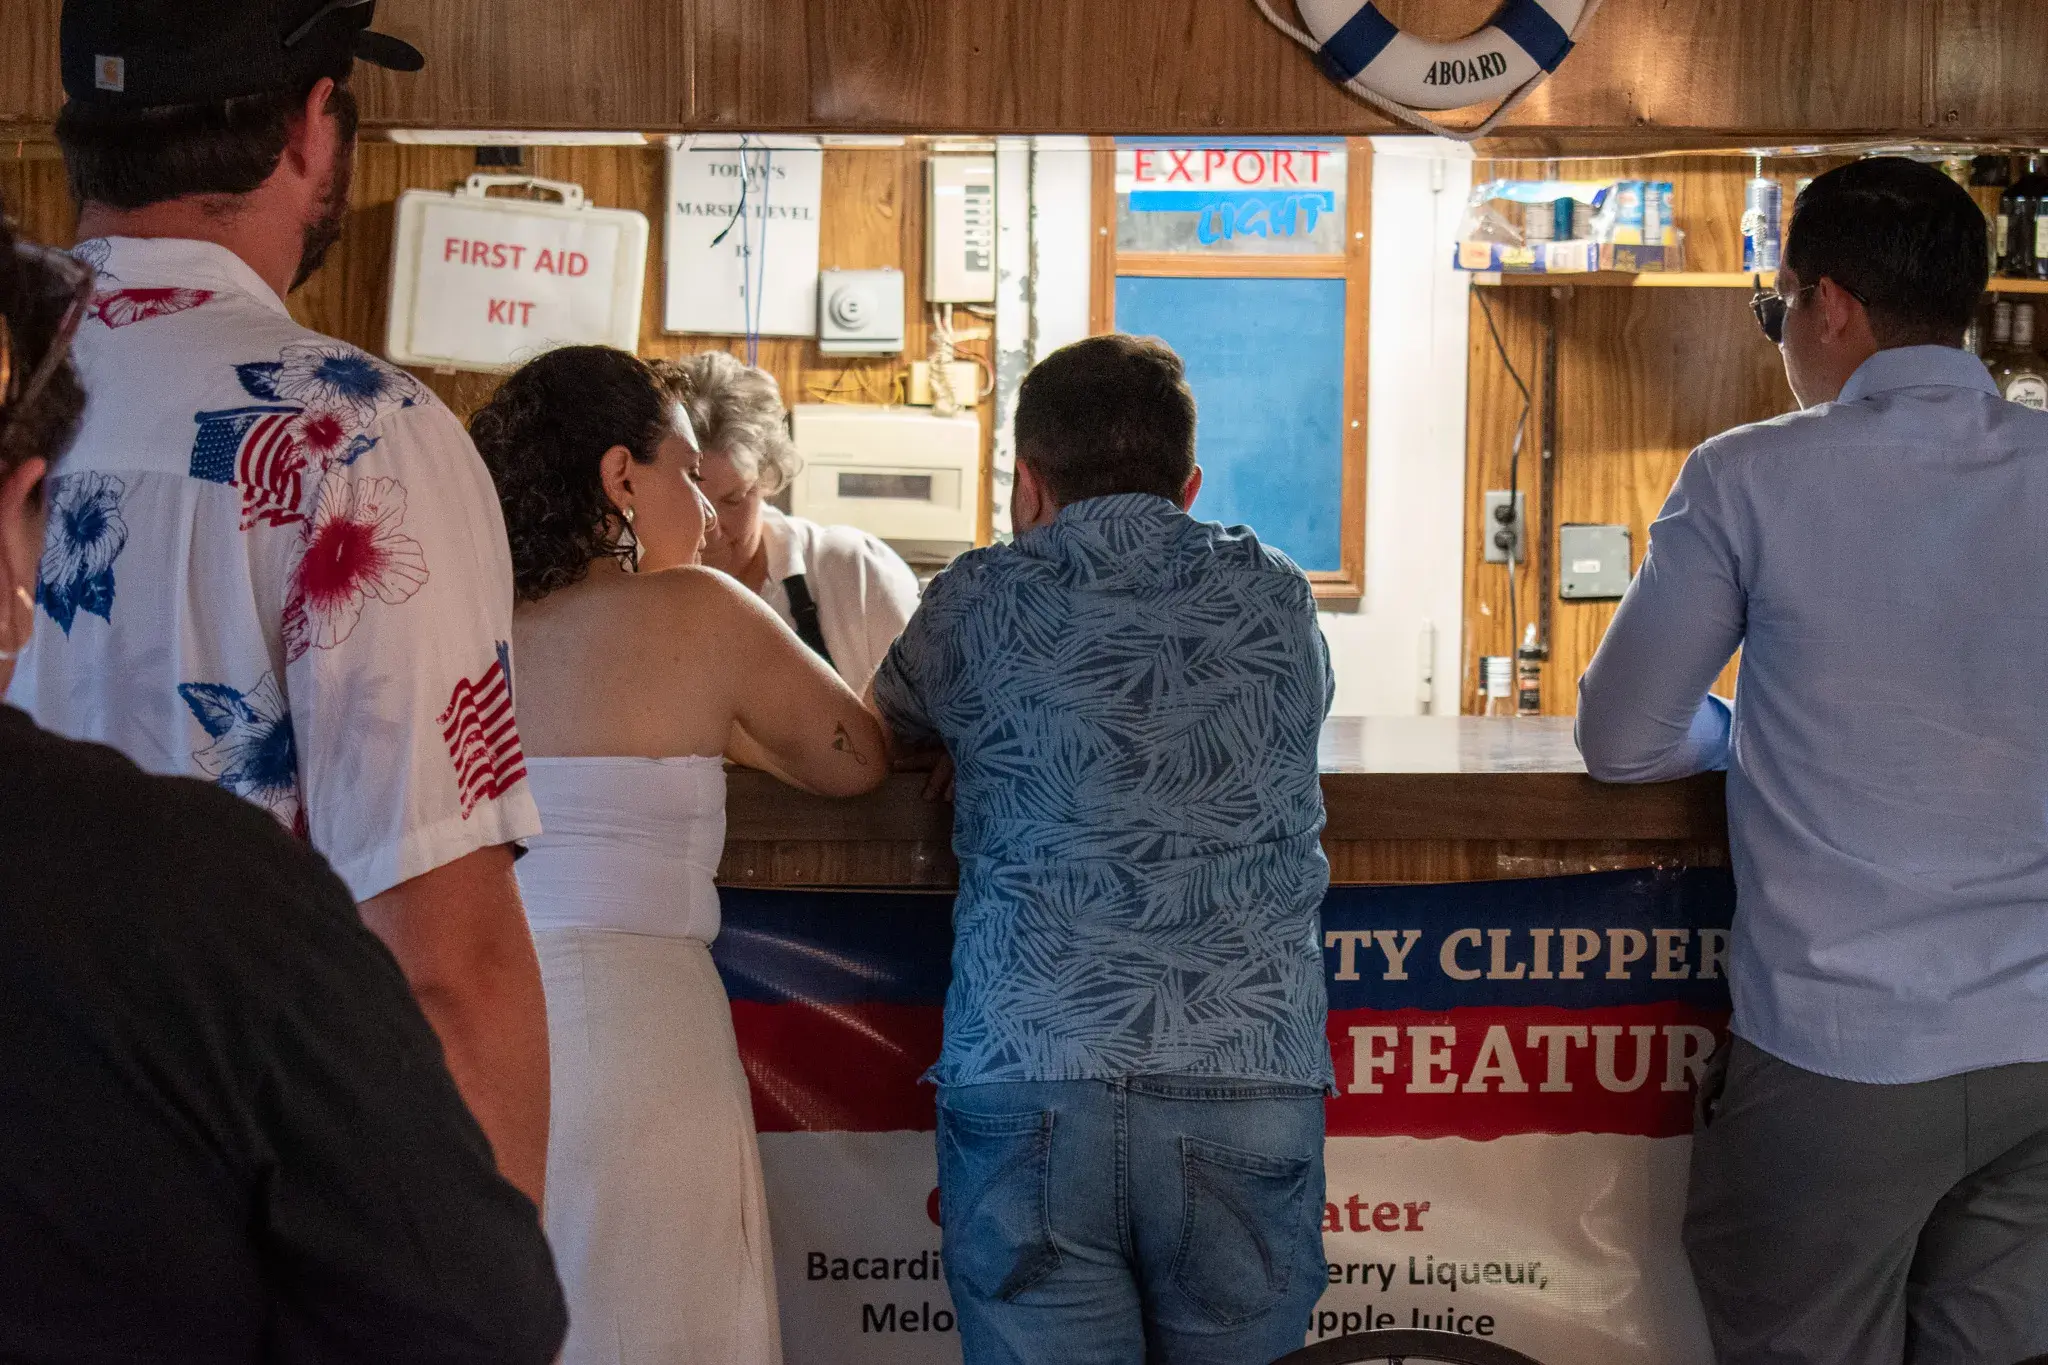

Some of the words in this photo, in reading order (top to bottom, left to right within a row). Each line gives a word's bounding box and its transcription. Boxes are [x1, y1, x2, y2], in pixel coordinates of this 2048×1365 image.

[1423, 51, 1507, 85] ABOARD
[708, 163, 786, 180] TODAY'S
[1134, 149, 1331, 185] EXPORT
[756, 205, 814, 220] LEVEL
[1196, 194, 1327, 247] LIGHT
[443, 237, 526, 270] FIRST
[534, 248, 589, 277] AID
[735, 244, 752, 258] IS
[487, 299, 536, 328] KIT
[1325, 930, 1422, 981] TY
[1439, 928, 1729, 980] CLIPPER
[1348, 1025, 1717, 1094] FEATUR
[1322, 1193, 1431, 1233] ater
[807, 1250, 941, 1281] Bacardi
[1328, 1262, 1396, 1292] erry
[1408, 1255, 1548, 1292] Liqueur,
[862, 1301, 960, 1333] Melo
[1411, 1307, 1496, 1336] Juice
